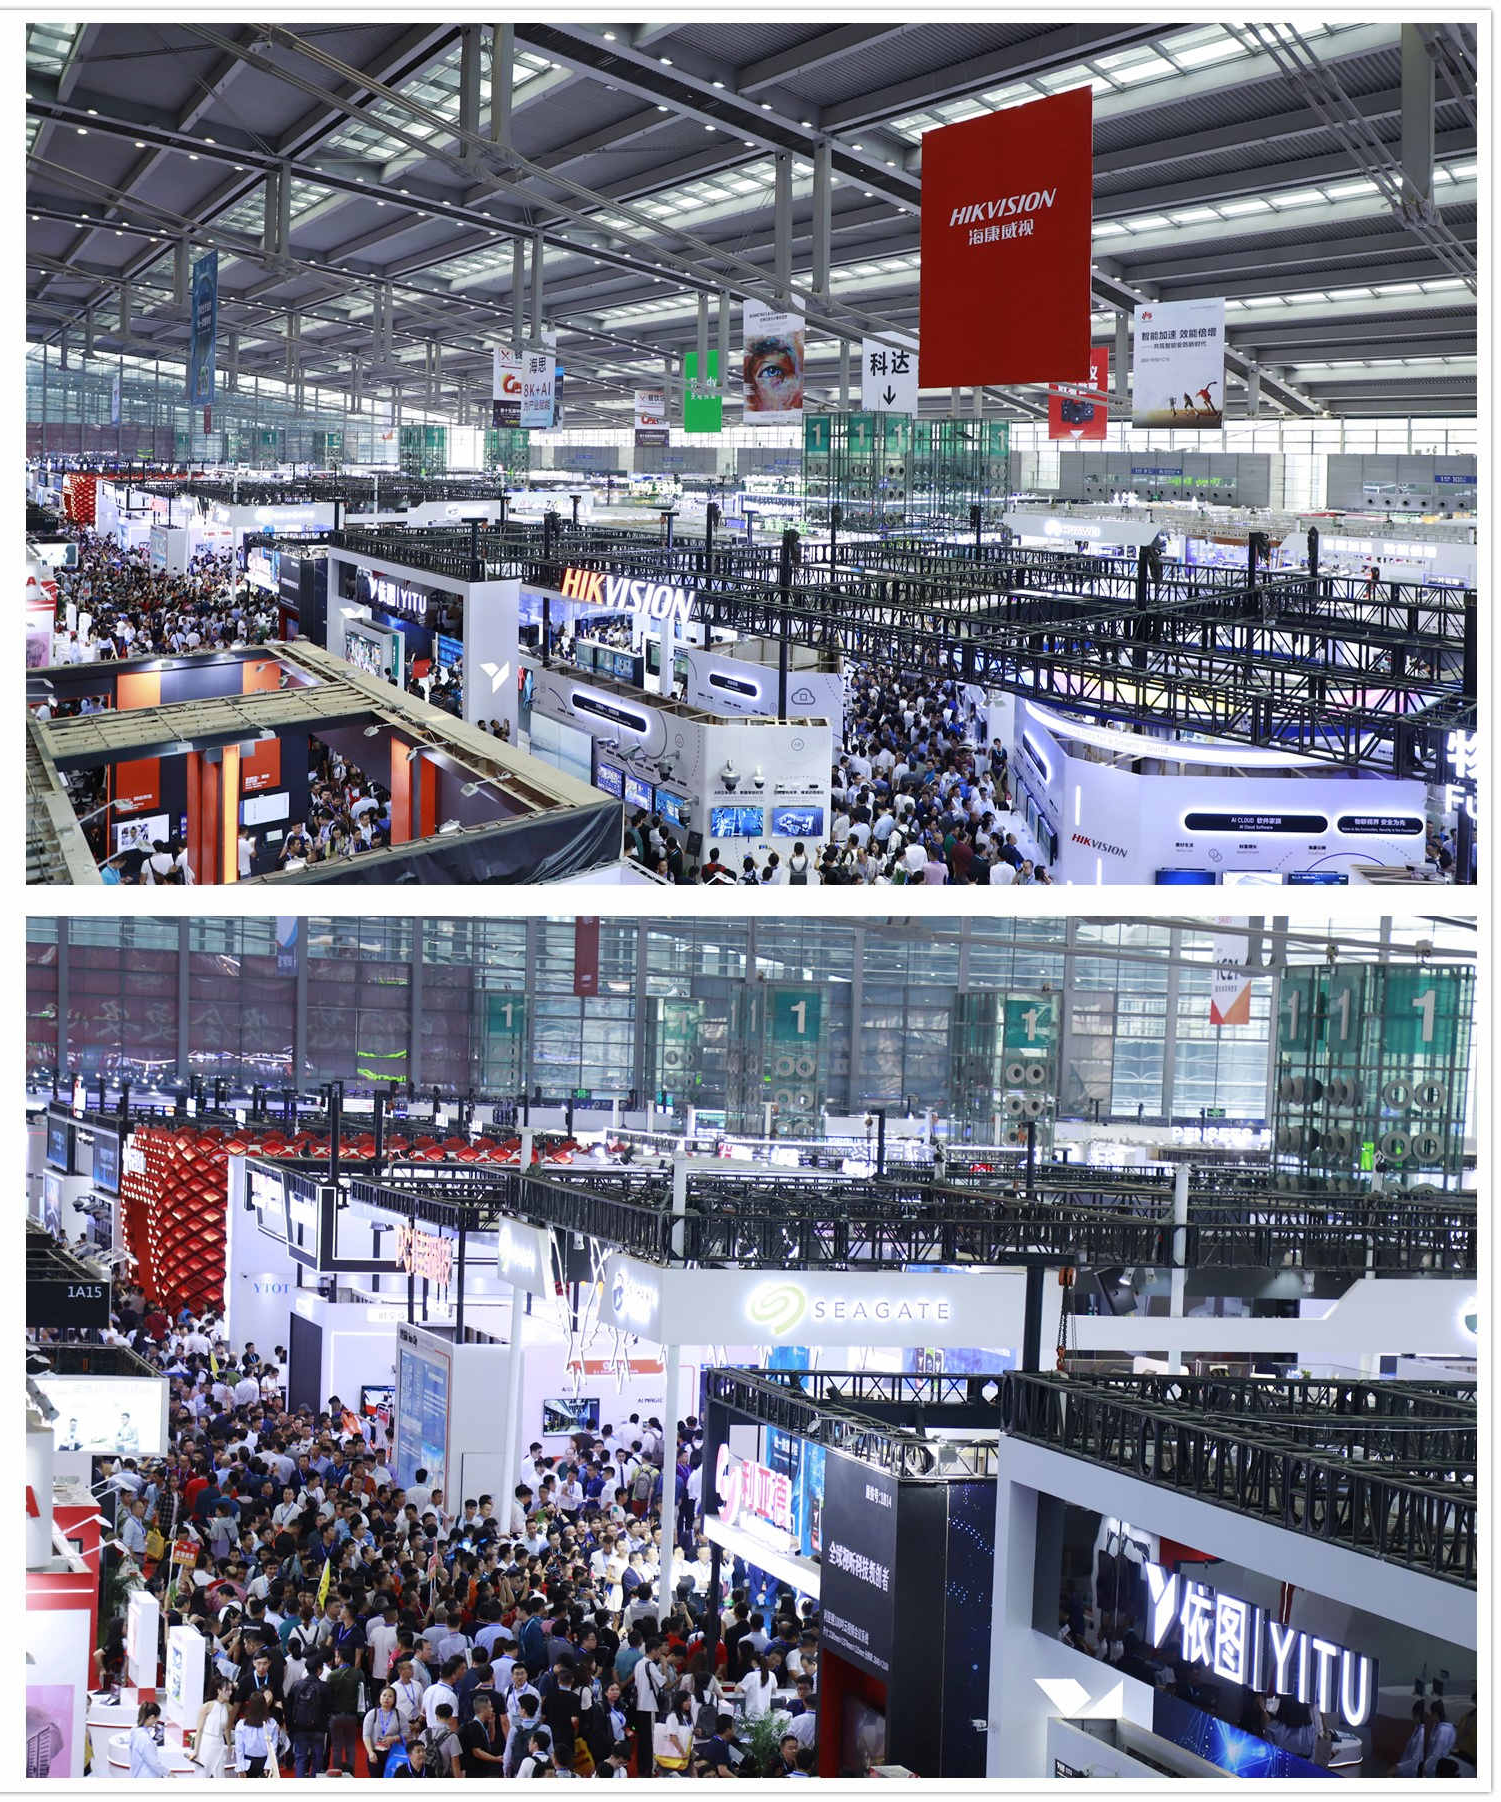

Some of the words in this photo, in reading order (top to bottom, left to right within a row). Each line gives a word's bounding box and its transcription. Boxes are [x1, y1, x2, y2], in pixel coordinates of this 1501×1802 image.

[949, 188, 1058, 227] HIKVISION
[969, 218, 1034, 246] 海康威视
[1141, 329, 1177, 342] 智能加速
[1179, 327, 1218, 339] 效能倍增
[869, 350, 910, 377] 科达
[523, 382, 551, 398] 8K+AI
[812, 423, 821, 447] 1
[855, 423, 865, 447] 1
[894, 424, 903, 447] 1
[400, 588, 427, 615] YITU
[561, 567, 696, 624] HIKVISION
[1071, 833, 1130, 858] HIKVISION
[501, 1003, 513, 1028] 1
[790, 1000, 806, 1034] 1
[1021, 1008, 1037, 1041] 1
[1286, 990, 1300, 1040] 1
[1338, 988, 1351, 1040] 1
[1413, 990, 1436, 1042] 1
[67, 1286, 103, 1299] 1A15
[814, 1301, 950, 1320] SEAGATE
[1180, 1579, 1249, 1686] 依图
[1269, 1620, 1370, 1728] YITU
